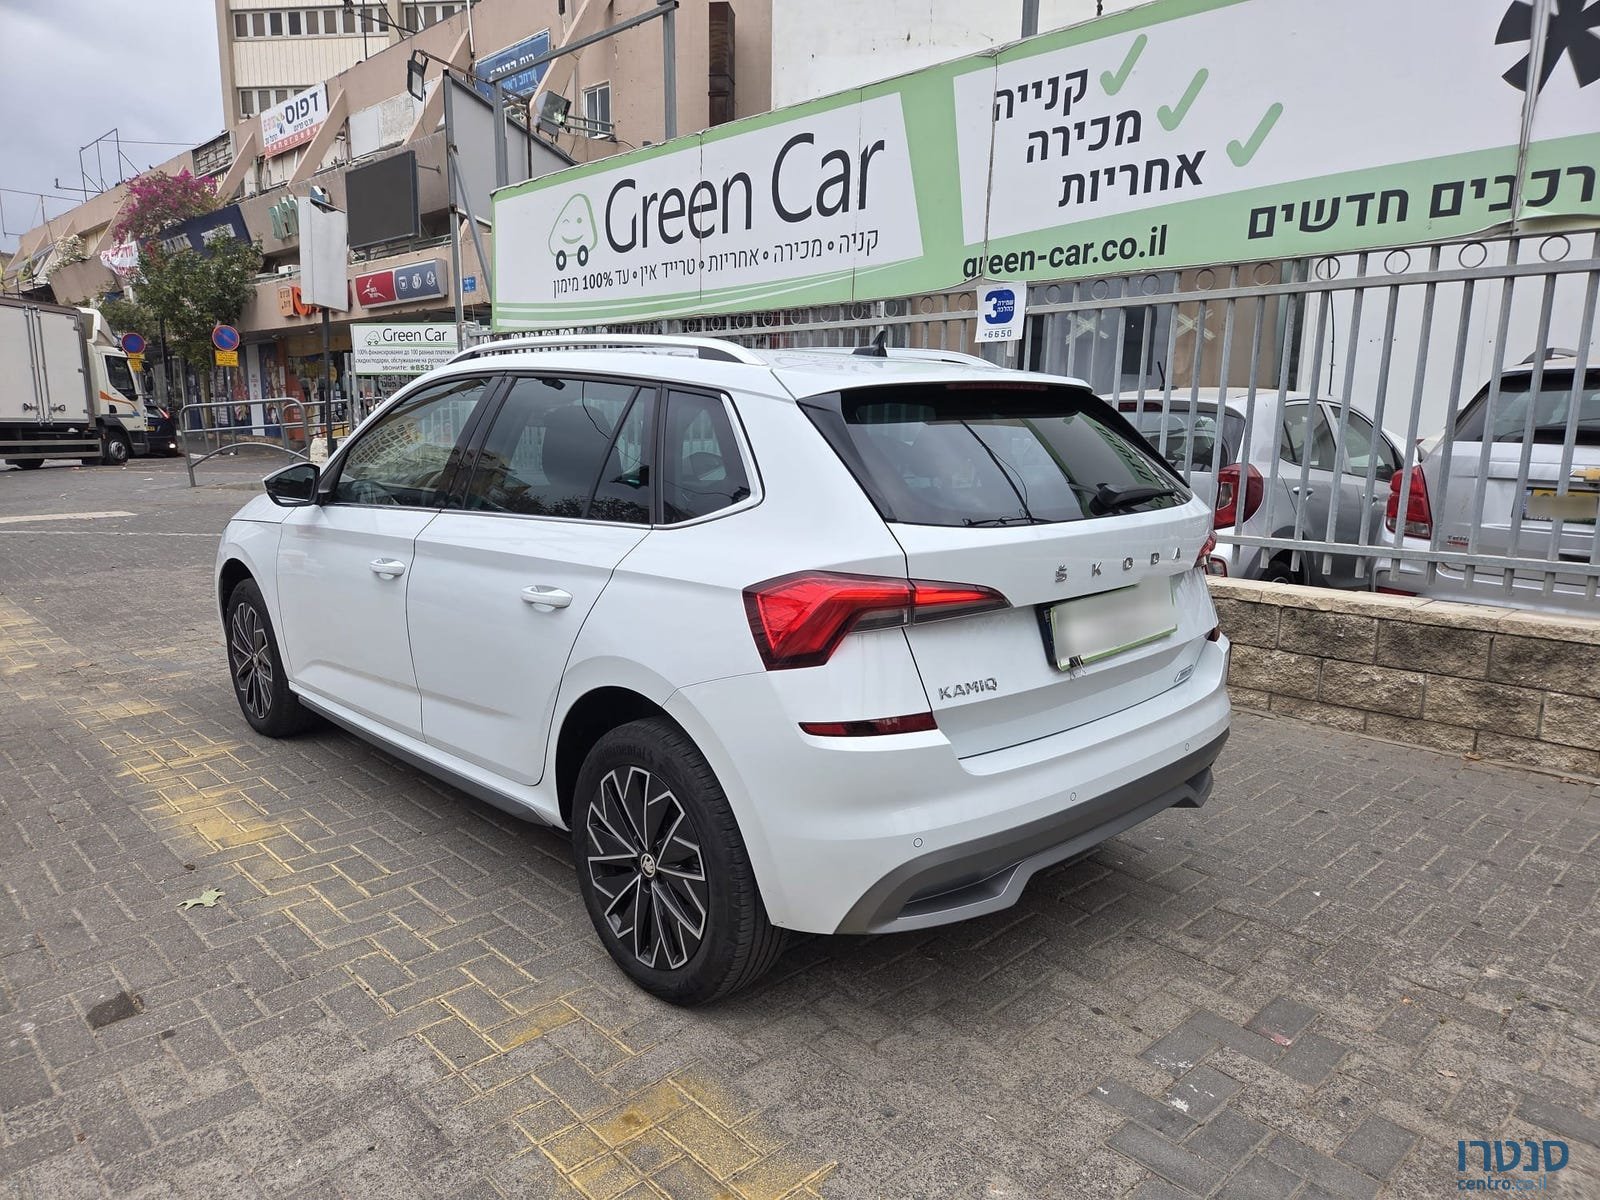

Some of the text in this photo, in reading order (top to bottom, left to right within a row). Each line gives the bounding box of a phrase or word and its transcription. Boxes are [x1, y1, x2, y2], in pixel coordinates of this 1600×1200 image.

[285, 92, 318, 124] דפוס
[995, 68, 1089, 121] קנייה
[1026, 109, 1142, 164] מכירה
[605, 132, 885, 254] Green Car
[1058, 150, 1207, 208] אחריות
[1247, 165, 1597, 240] רכבים חדשים
[553, 229, 879, 298] קניה מכירה אחריות טרייד אין עד 100% מימון
[963, 224, 1168, 281] green-car.co.il
[382, 327, 447, 342] Green Car
[1055, 547, 1181, 583] ŠKODA
[938, 677, 998, 700] KAMIQ
